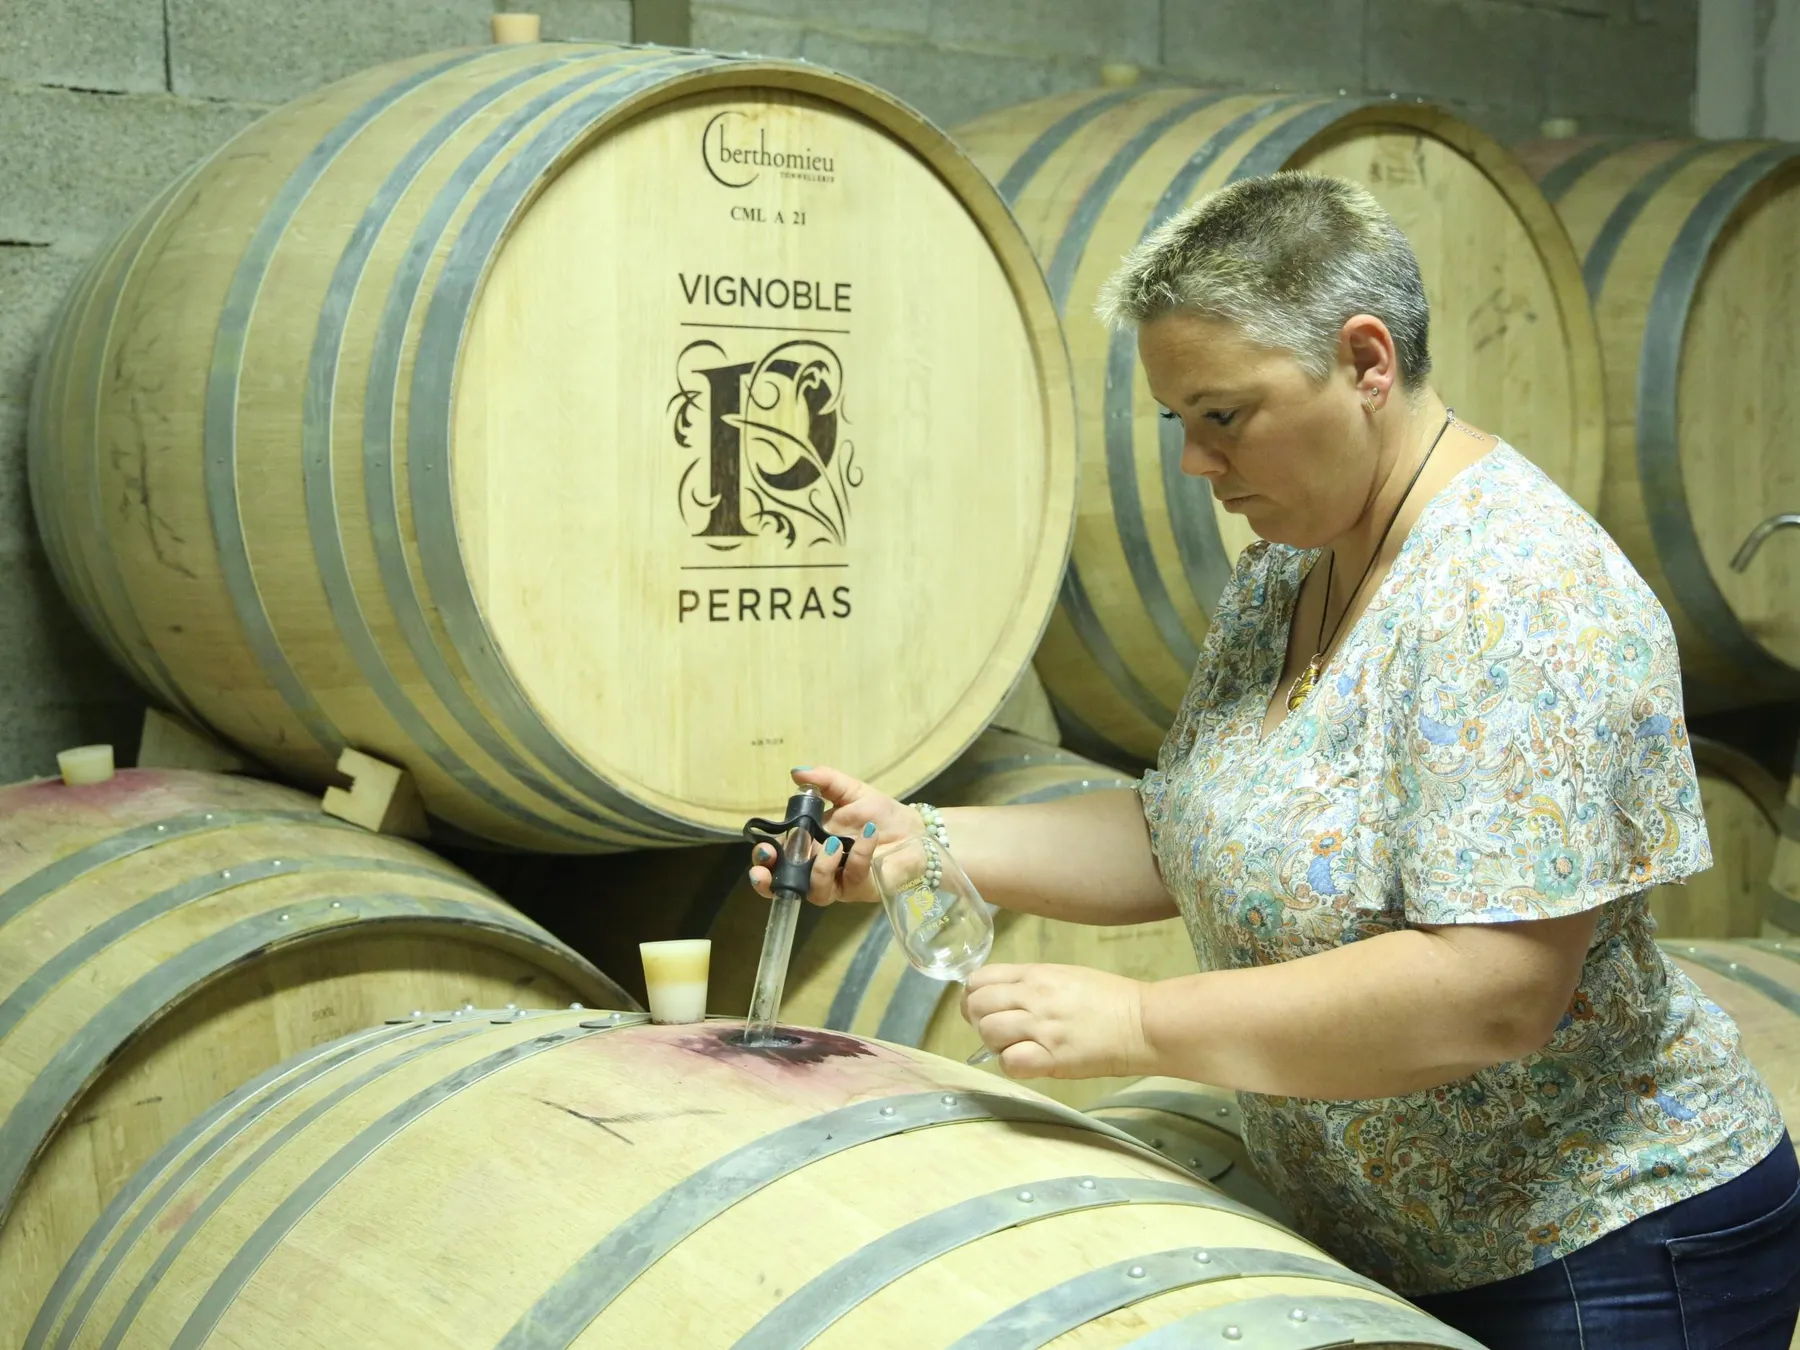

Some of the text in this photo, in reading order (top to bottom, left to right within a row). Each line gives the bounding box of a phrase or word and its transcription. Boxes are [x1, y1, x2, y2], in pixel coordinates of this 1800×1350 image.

[719, 123, 835, 172] berthomieu
[730, 206, 806, 226] CML A 21
[678, 272, 852, 313] VIGNOBLE
[678, 585, 852, 623] PERRAS
